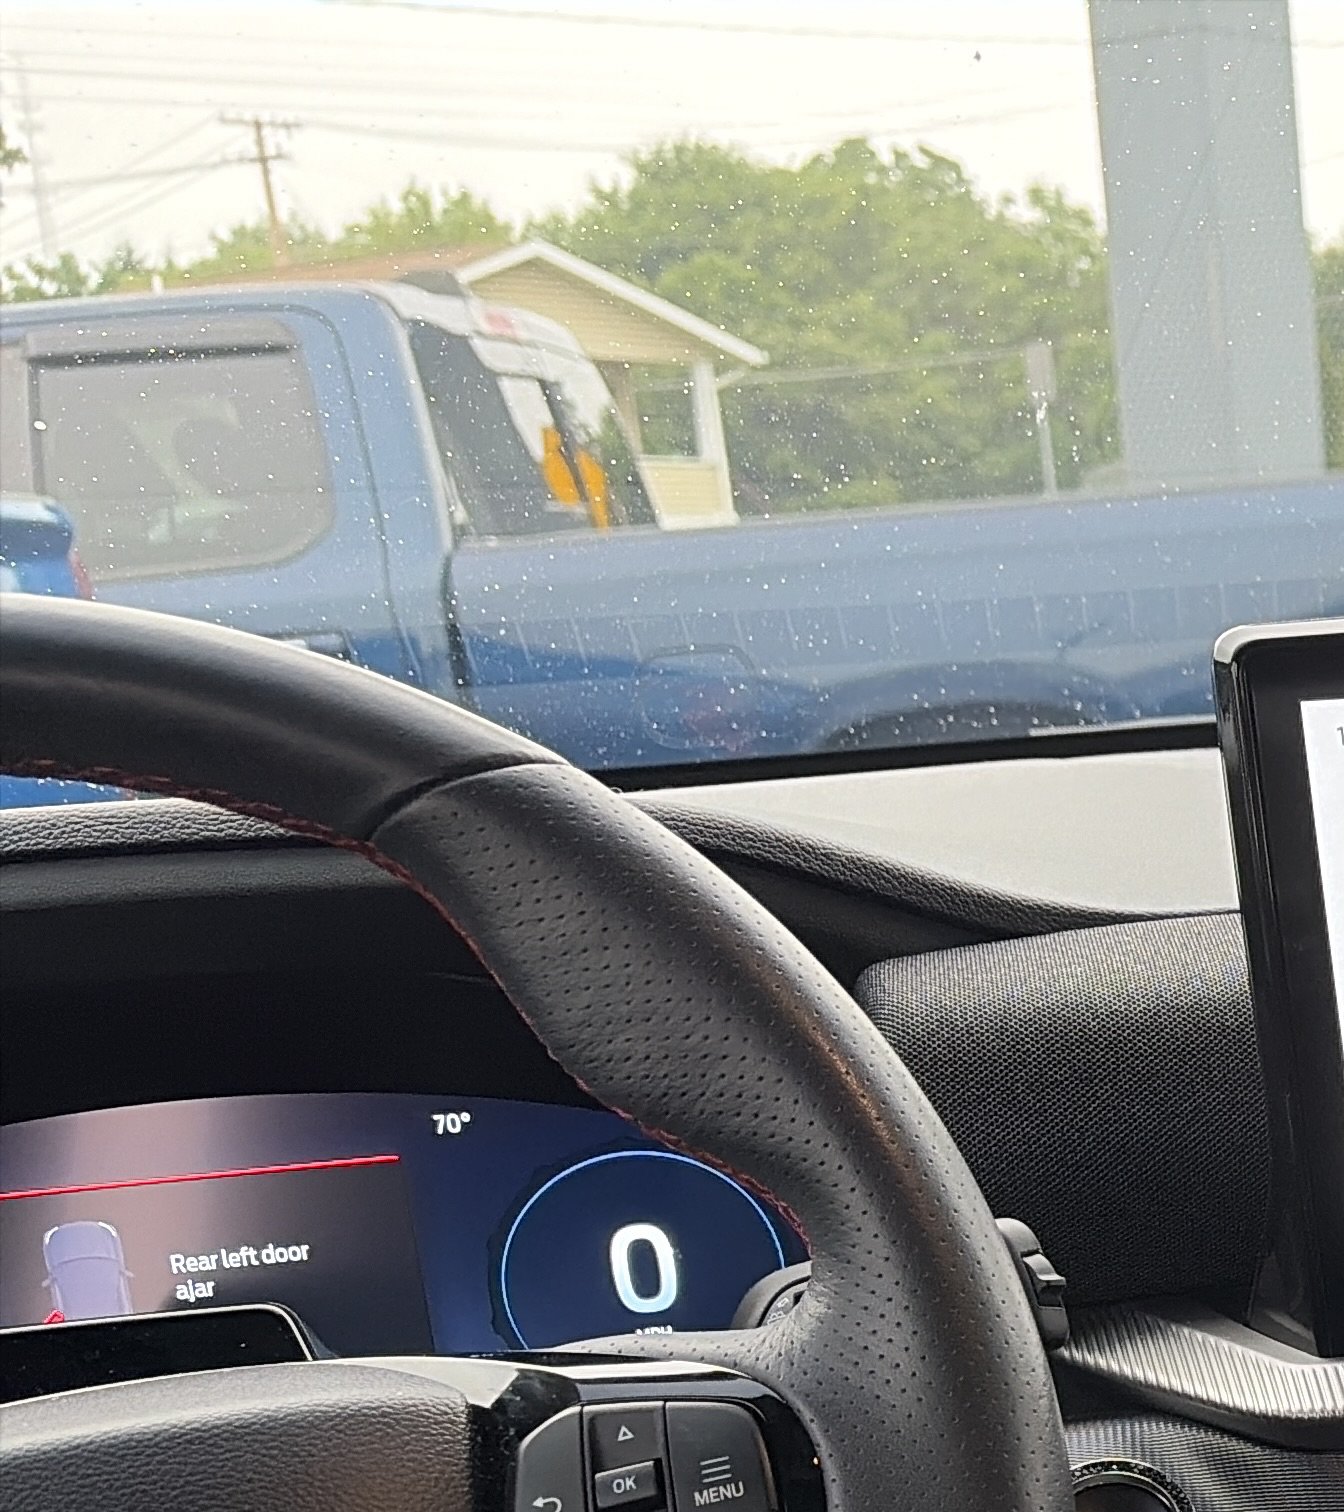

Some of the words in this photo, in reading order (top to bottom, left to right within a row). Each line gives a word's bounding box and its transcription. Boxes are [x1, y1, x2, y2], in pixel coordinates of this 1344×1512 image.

[431, 1111, 471, 1135] 70°
[170, 1252, 218, 1275] Rear
[221, 1246, 260, 1269] left
[261, 1242, 310, 1264] door
[609, 1222, 679, 1314] 0
[175, 1279, 215, 1303] ajar
[612, 1476, 637, 1494] OK
[694, 1480, 745, 1506] MENU
